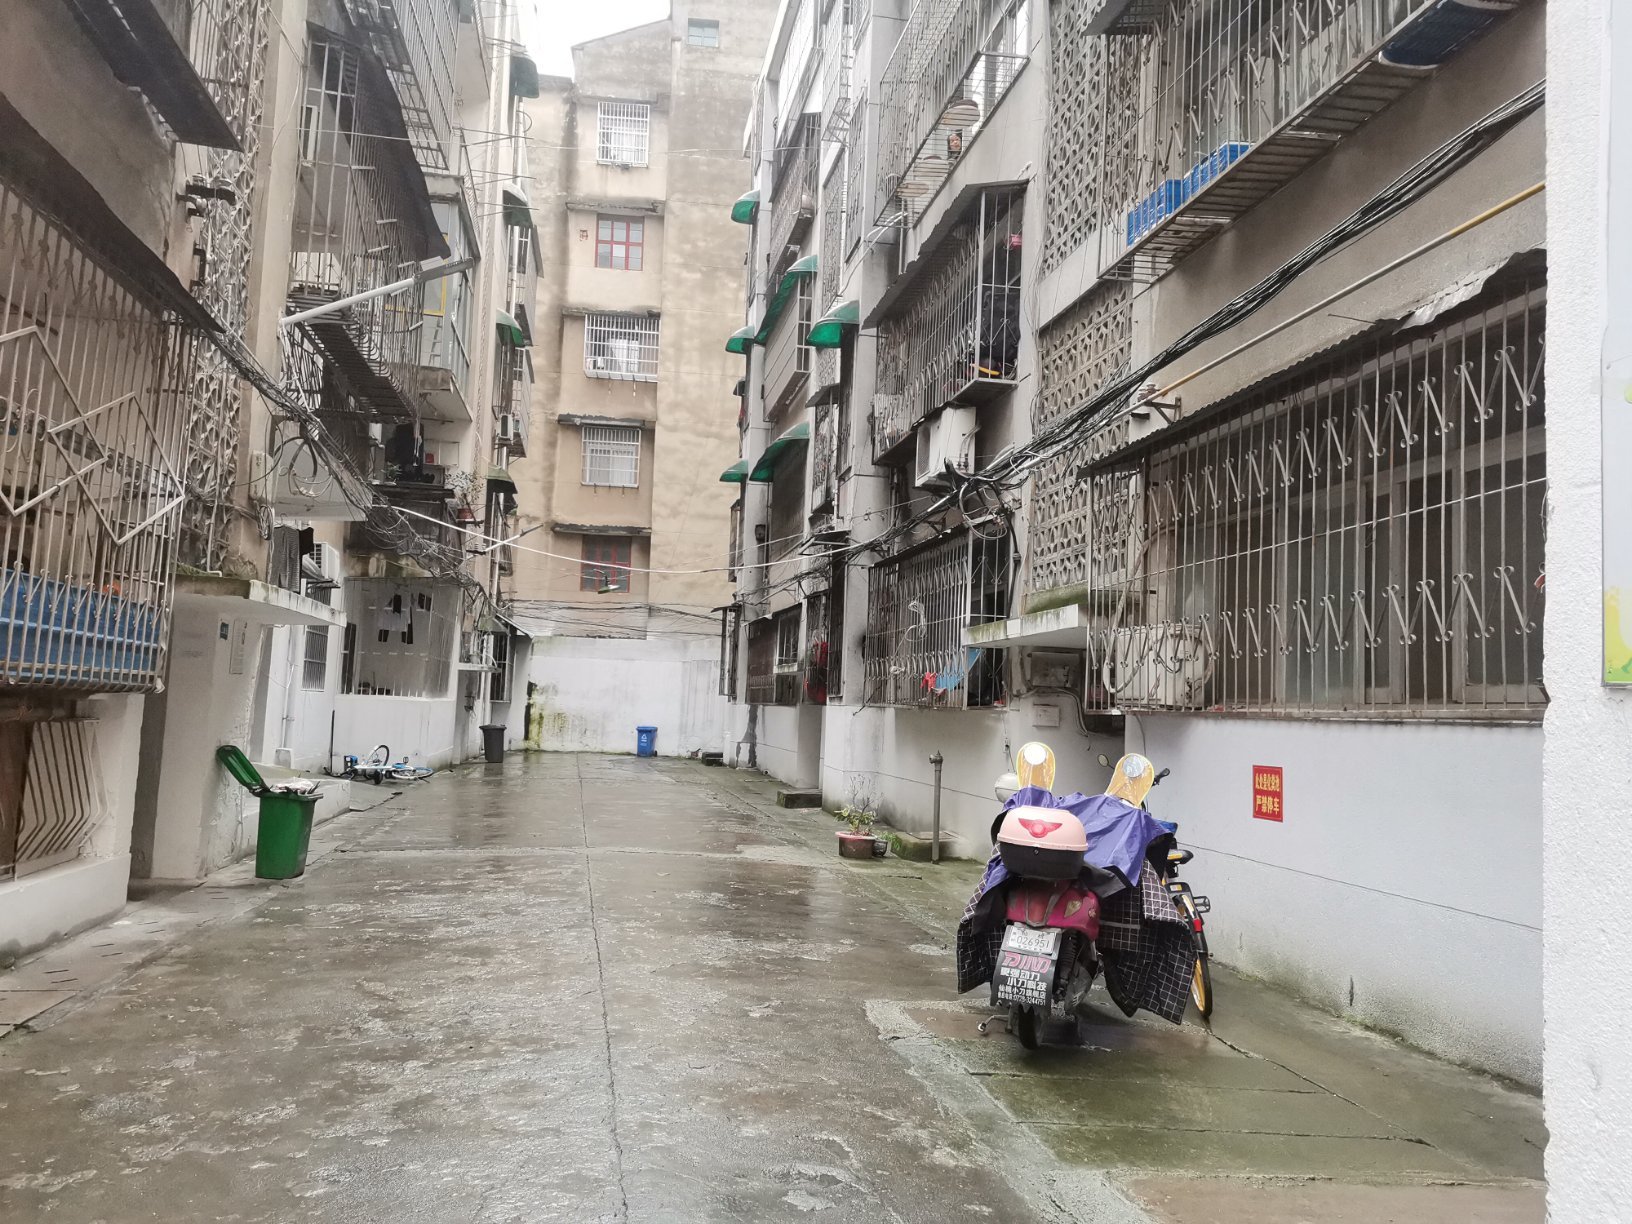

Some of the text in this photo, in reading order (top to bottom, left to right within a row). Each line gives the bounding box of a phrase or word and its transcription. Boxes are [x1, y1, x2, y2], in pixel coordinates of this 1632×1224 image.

[1256, 795, 1280, 815] 严禁停车
[1017, 936, 1049, 948] 026951
[1007, 977, 1047, 991] 小刀科技
